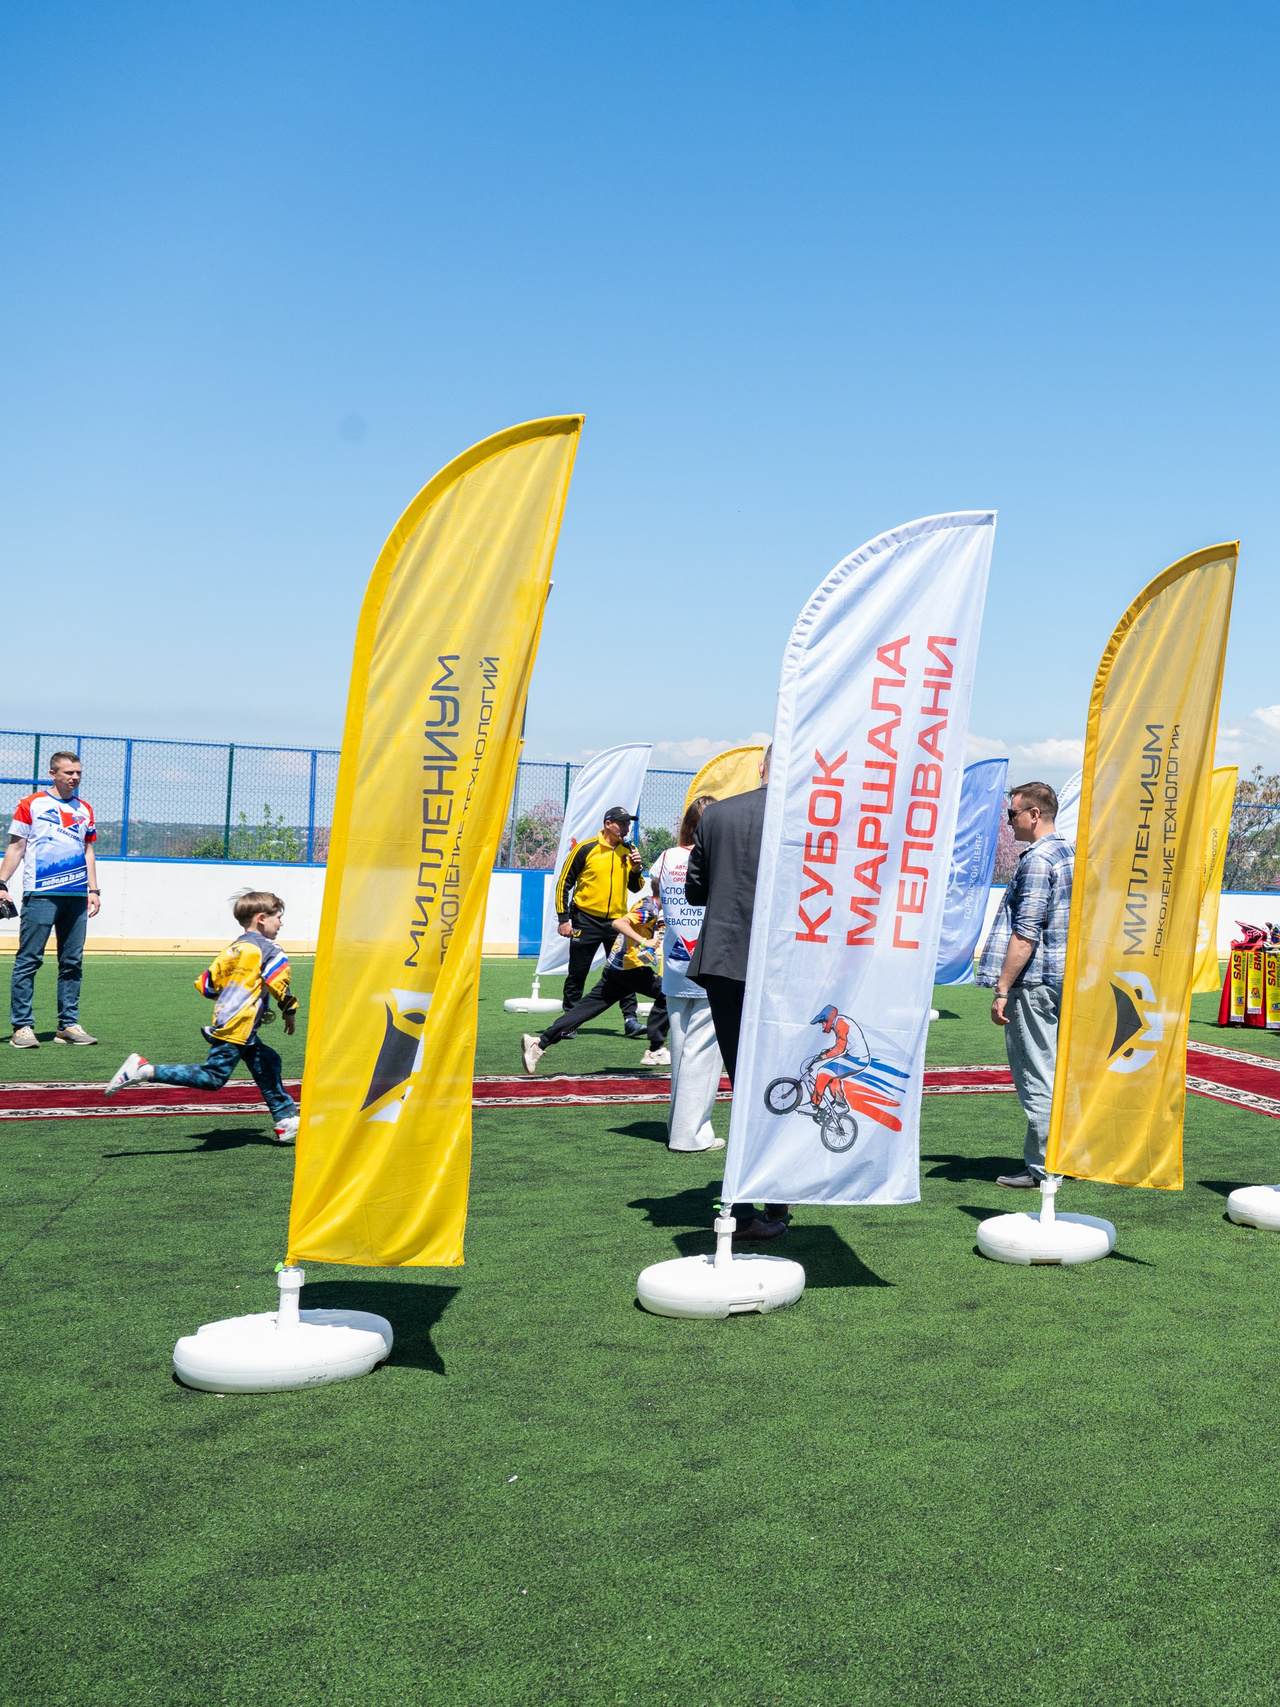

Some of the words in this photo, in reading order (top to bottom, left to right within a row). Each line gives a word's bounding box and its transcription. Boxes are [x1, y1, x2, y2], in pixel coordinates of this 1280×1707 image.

[404, 655, 460, 967] МИЛЛЕНИУМ
[846, 634, 911, 946] МАРШАЛА
[892, 635, 957, 950] ГЕЛОВАНИ
[1123, 724, 1164, 956] МИЛЛЕНИУМ
[1163, 724, 1181, 844] ТЕХНОЛОГИЙ
[795, 748, 848, 944] КУБОК
[964, 865, 979, 919] ГОРОДСКОЙ
[973, 833, 983, 862] ЦЕНТР
[1153, 847, 1176, 957] ПОКОЛЕНИЕ
[680, 908, 702, 916] КЛУБ
[1233, 954, 1241, 980] SVS
[1267, 960, 1276, 987] SVS
